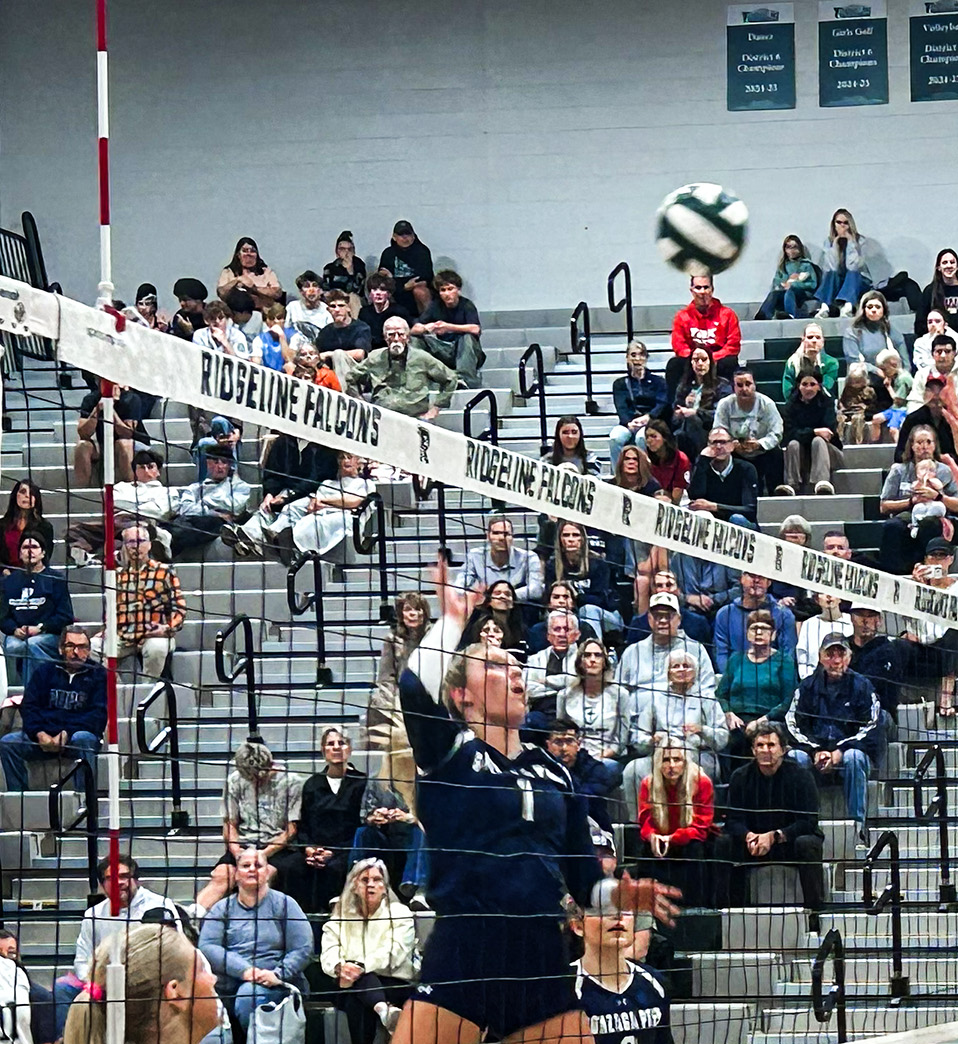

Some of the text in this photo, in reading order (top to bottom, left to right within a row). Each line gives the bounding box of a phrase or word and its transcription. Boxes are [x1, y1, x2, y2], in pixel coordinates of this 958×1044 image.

[201, 351, 382, 447] RIDGELINE FALCONS
[466, 440, 596, 515] RIDGELINE FALCONS
